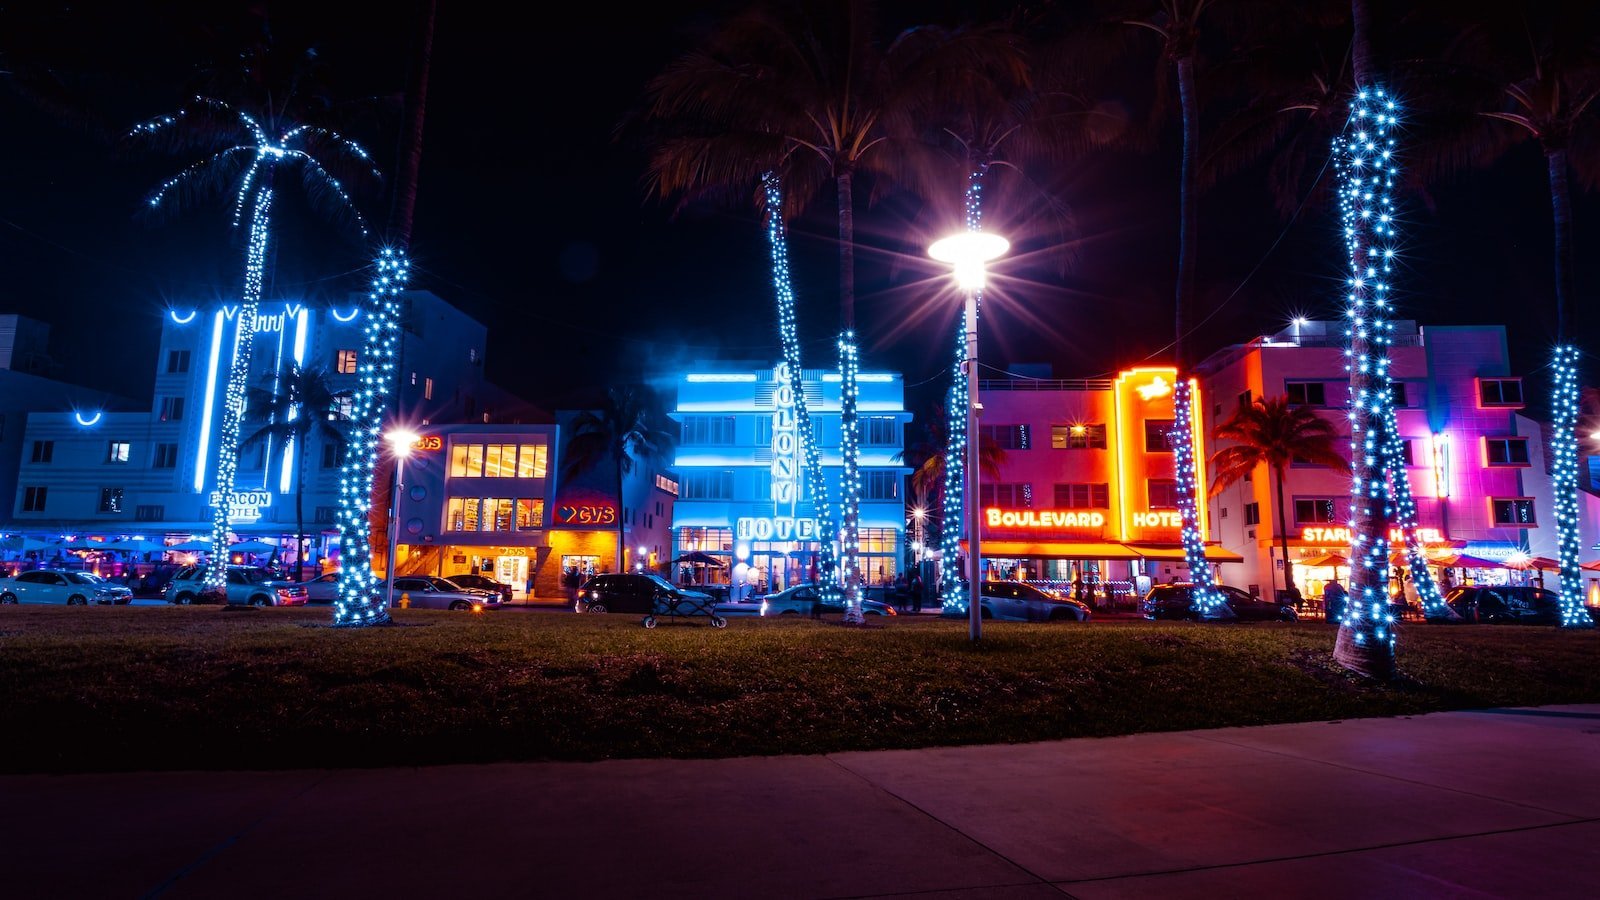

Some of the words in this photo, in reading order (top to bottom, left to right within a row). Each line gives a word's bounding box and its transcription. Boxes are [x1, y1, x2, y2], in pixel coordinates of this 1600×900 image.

[776, 362, 794, 501] COLONY
[209, 493, 270, 505] BACON
[227, 508, 260, 517] OTEL
[580, 506, 615, 523] CVS
[986, 508, 1104, 527] BOULEVARD
[1133, 511, 1183, 527] HOTE
[738, 518, 819, 538] HOTE
[1303, 527, 1352, 542] STARL
[1390, 528, 1445, 542] HTEL
[507, 548, 526, 556] CVS
